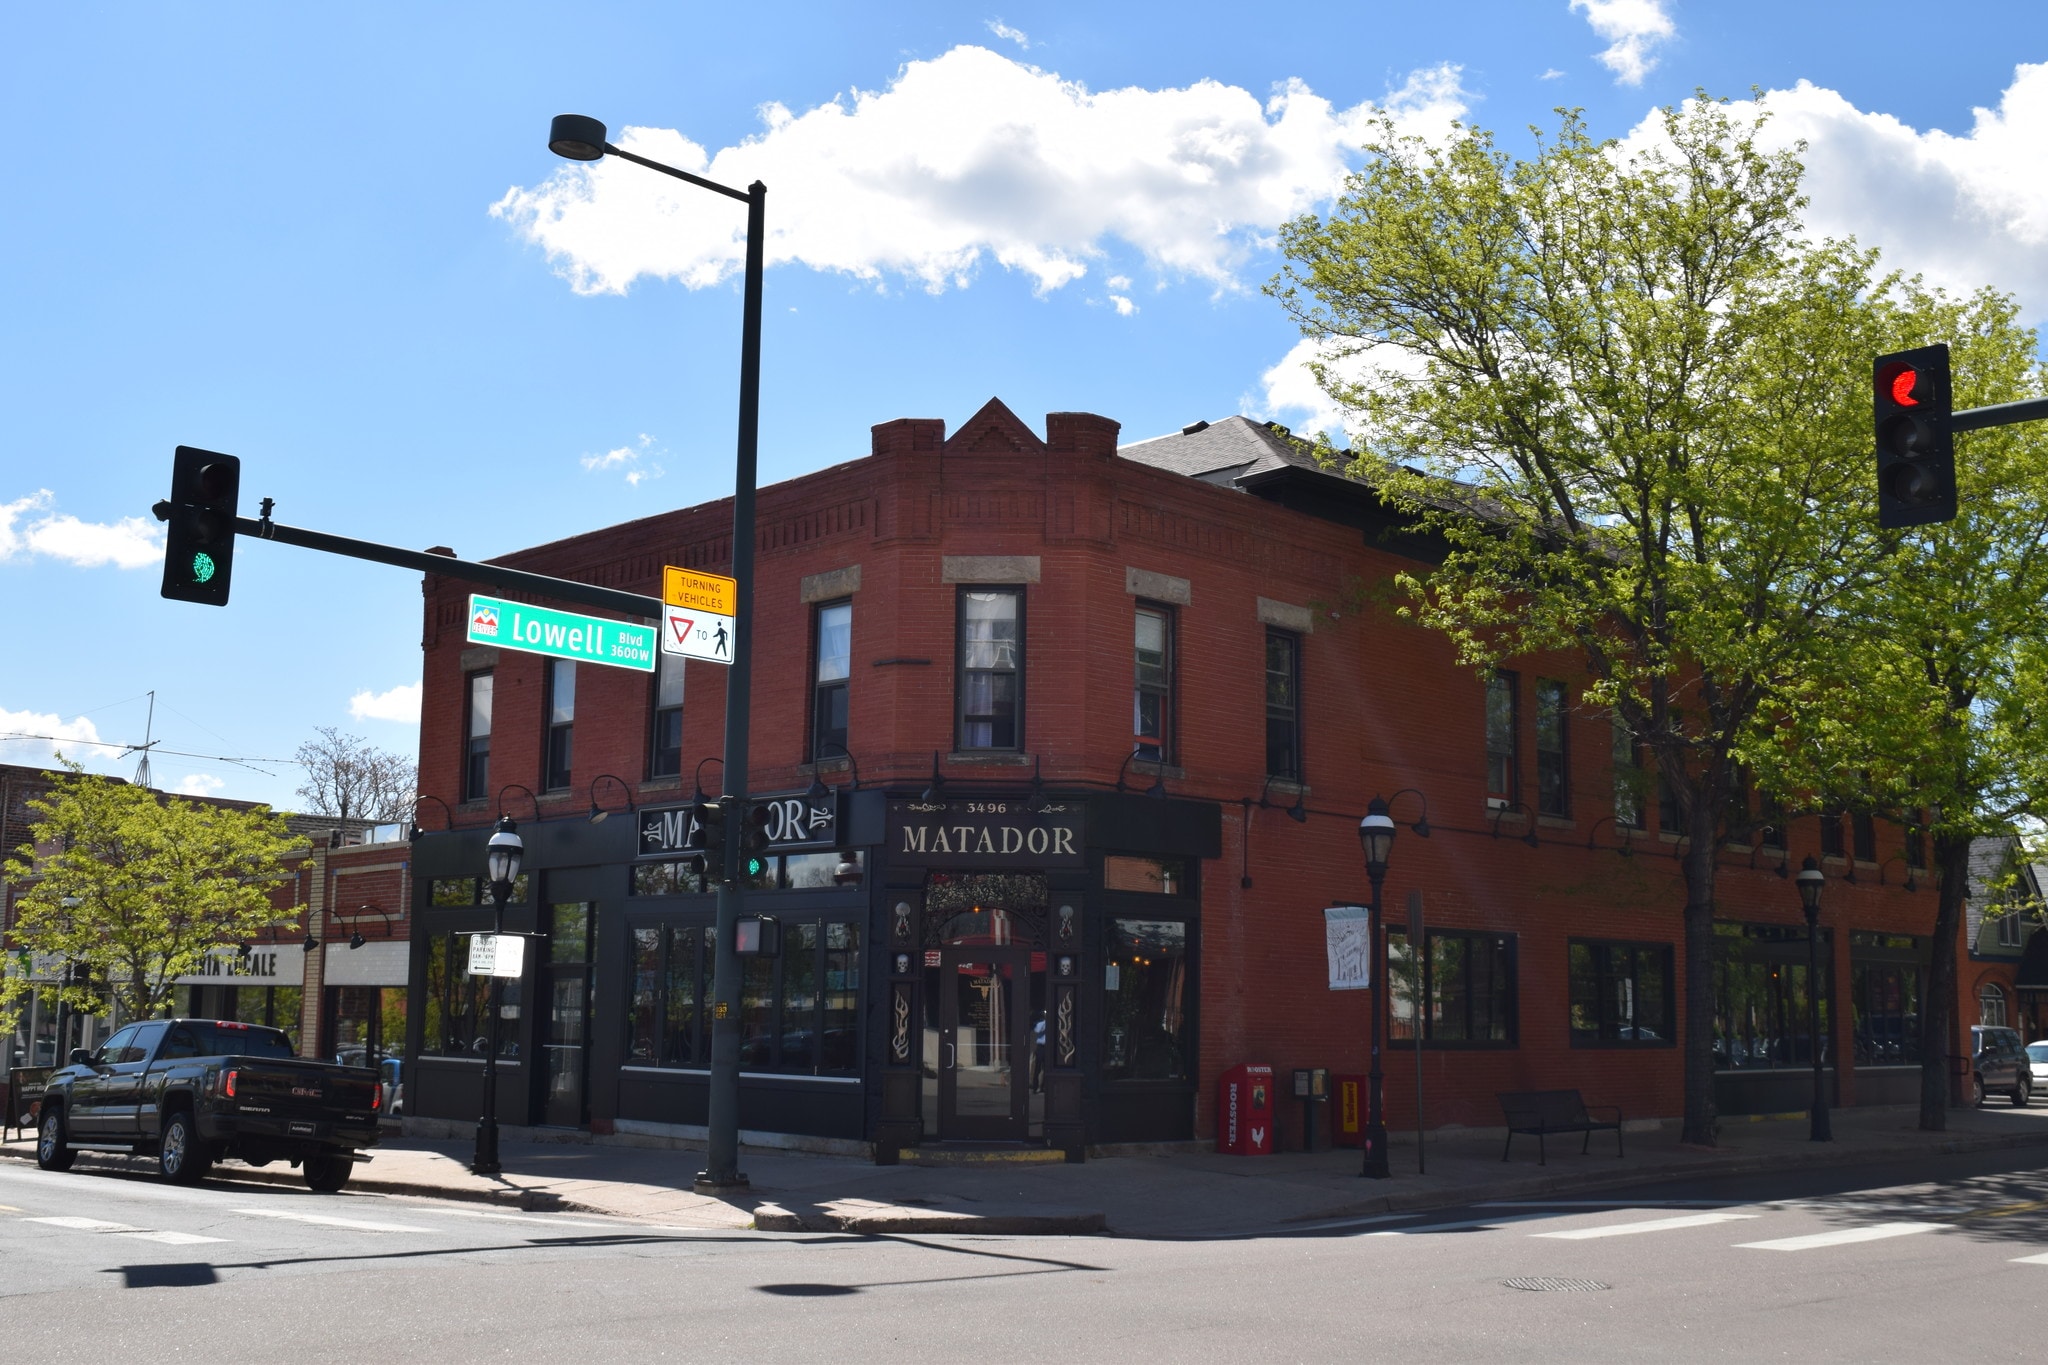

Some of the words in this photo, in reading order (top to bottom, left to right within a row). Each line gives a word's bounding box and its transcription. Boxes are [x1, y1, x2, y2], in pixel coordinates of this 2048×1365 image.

[681, 577, 721, 593] TURNING
[678, 592, 723, 609] VEHICLES
[472, 622, 497, 636] DENVER
[513, 613, 603, 655] Lowell
[619, 632, 643, 647] Blvd
[696, 630, 708, 641] TO
[967, 803, 1007, 813] 3496
[662, 799, 807, 849] MAOR
[902, 826, 1077, 855] MATADOR
[227, 954, 277, 976] LOCALE
[1229, 1083, 1238, 1142] ROOSTER
